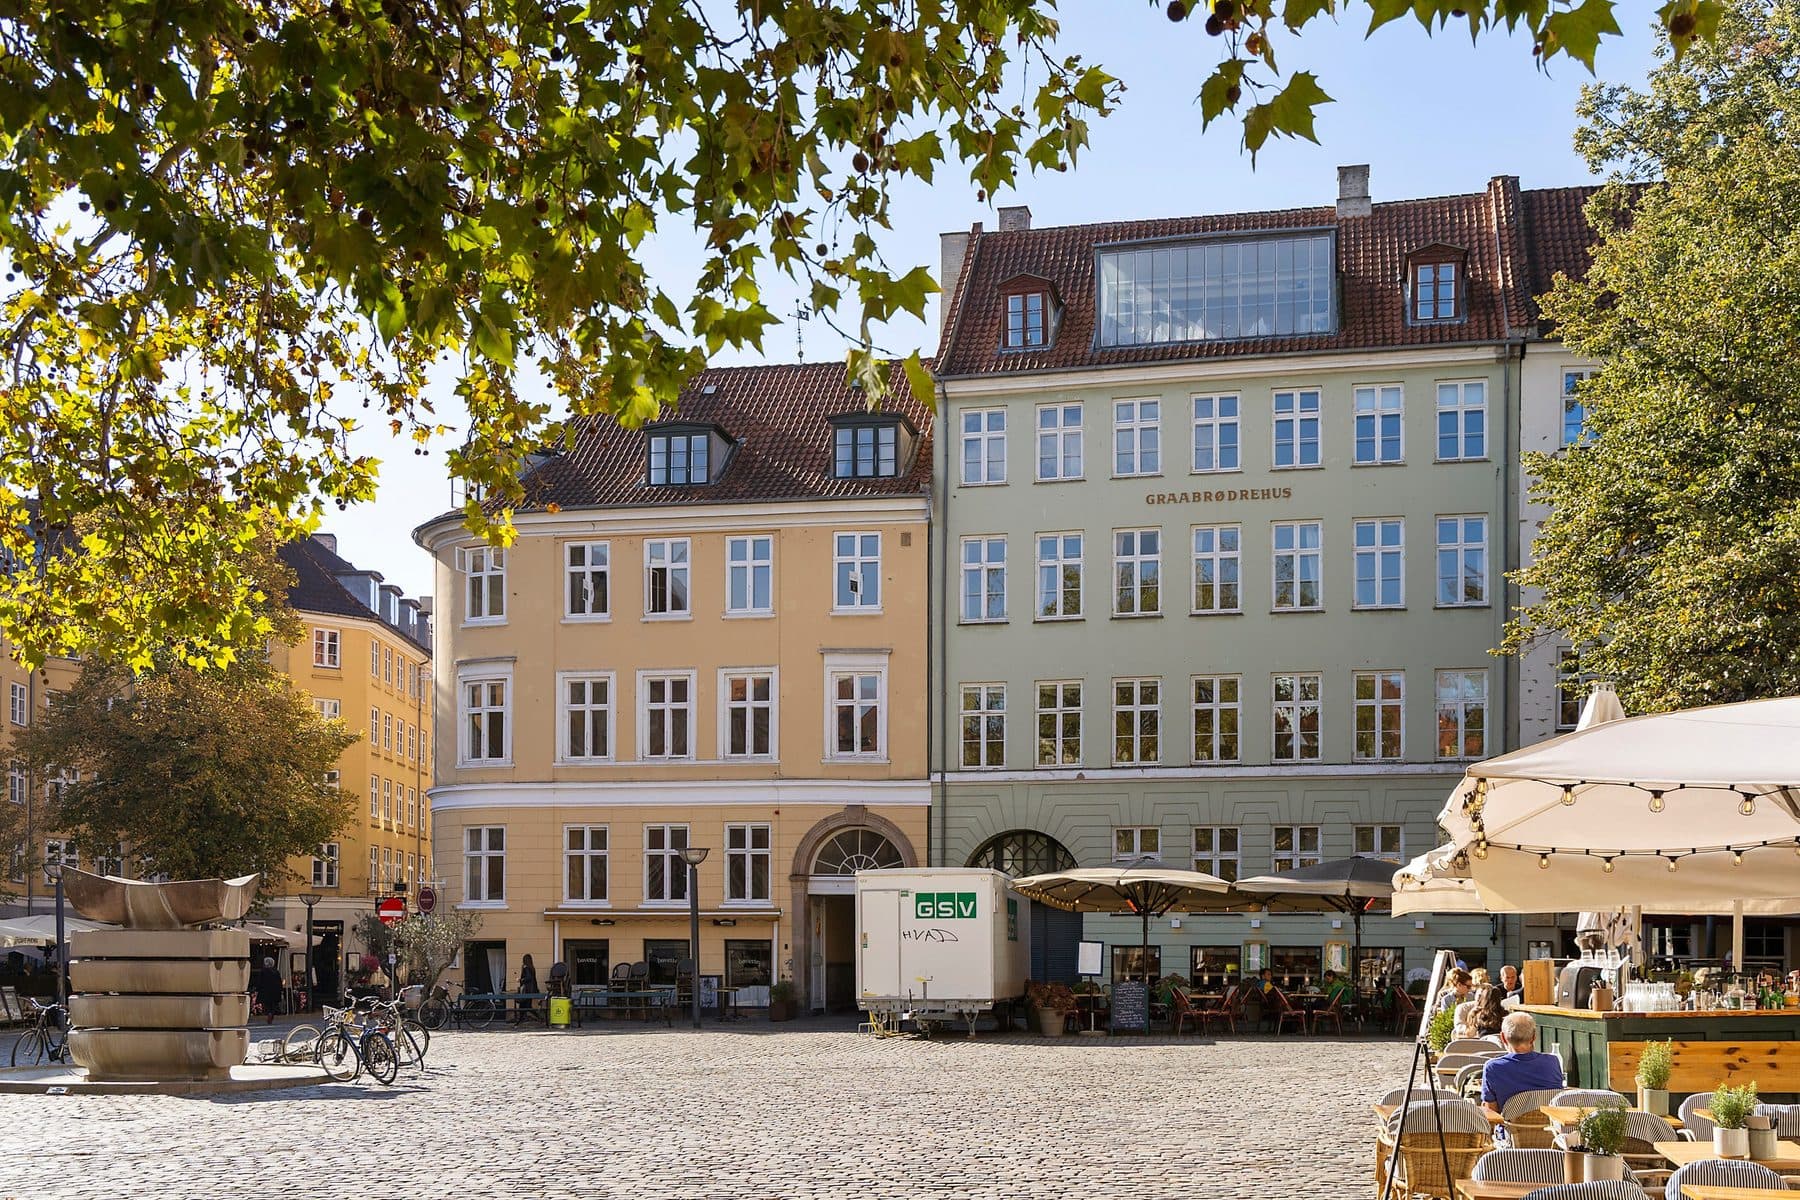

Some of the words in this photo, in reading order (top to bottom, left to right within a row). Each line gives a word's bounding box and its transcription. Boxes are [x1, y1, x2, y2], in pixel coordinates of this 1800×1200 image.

[1145, 487, 1292, 505] GRAABRØDREHUS
[917, 901, 975, 917] GSV
[902, 928, 959, 942] HVAD
